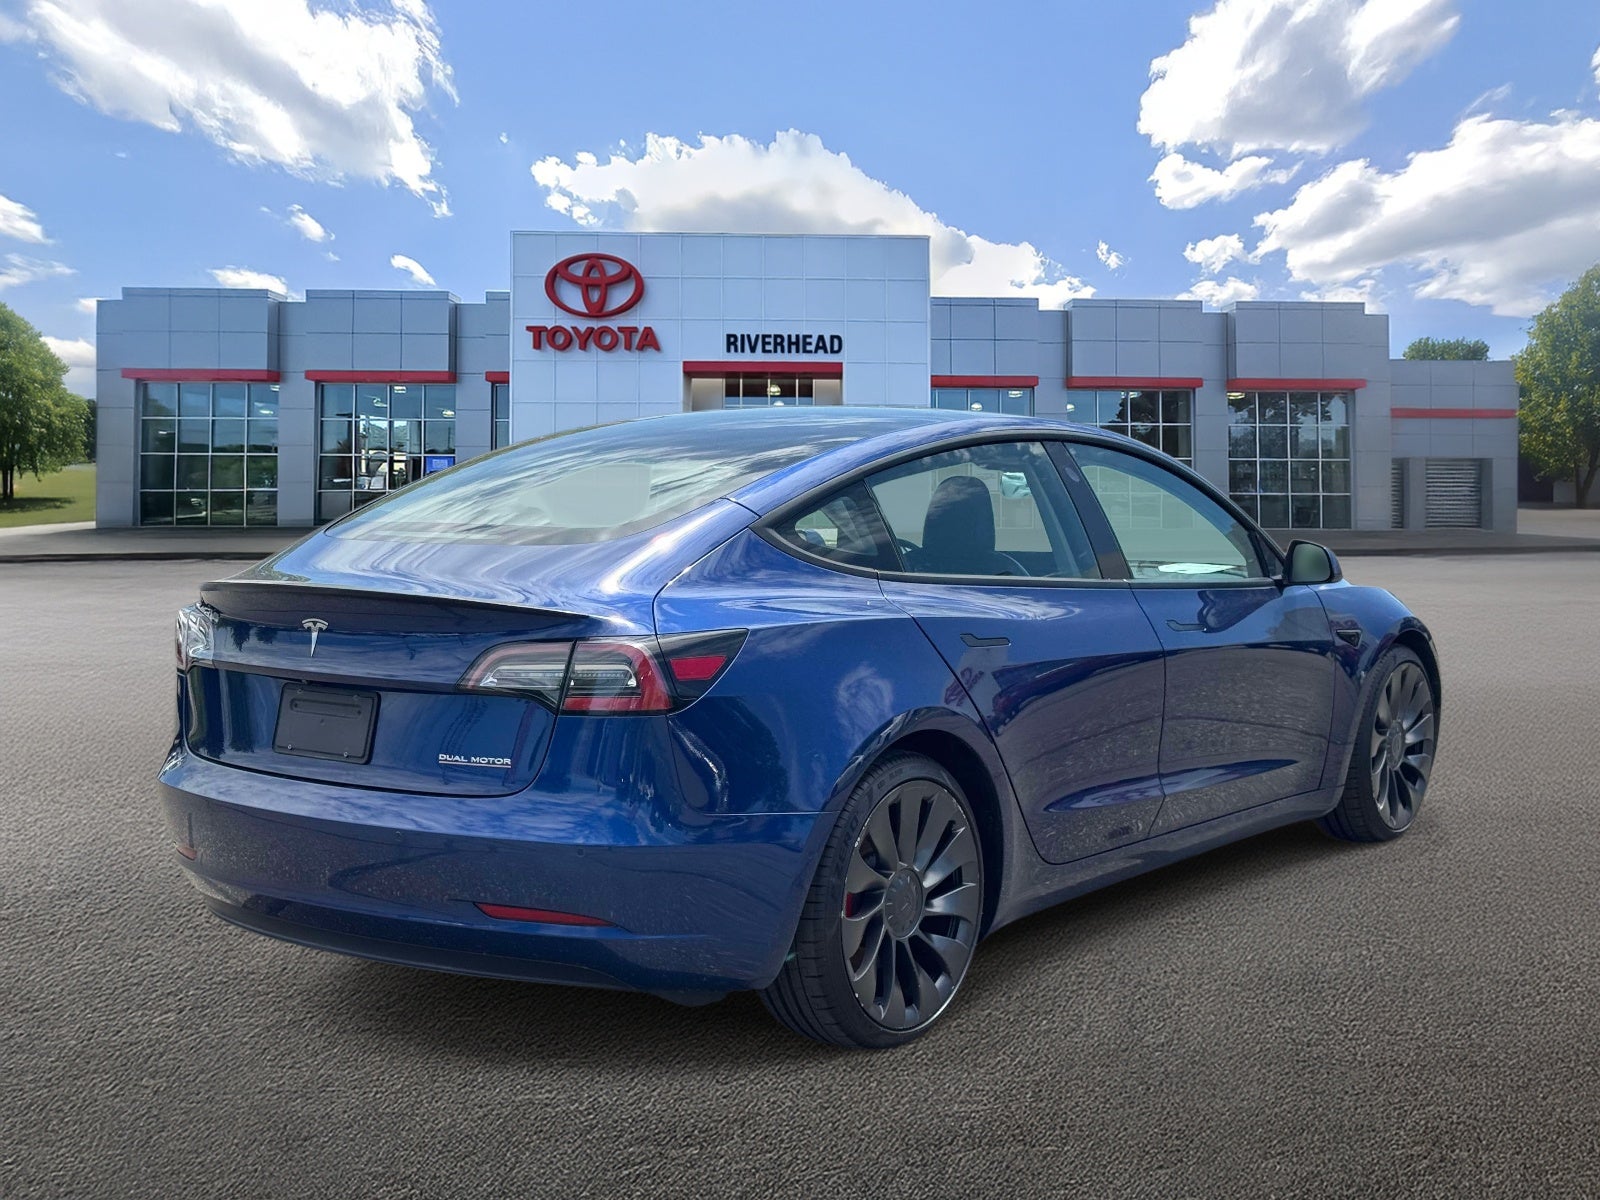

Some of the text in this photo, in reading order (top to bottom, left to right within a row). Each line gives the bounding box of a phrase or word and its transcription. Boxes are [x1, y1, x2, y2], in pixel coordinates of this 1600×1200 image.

[526, 325, 661, 351] TOYOTA
[726, 334, 843, 354] RIVERHEAD
[438, 753, 511, 765] DUAL MOTOR
